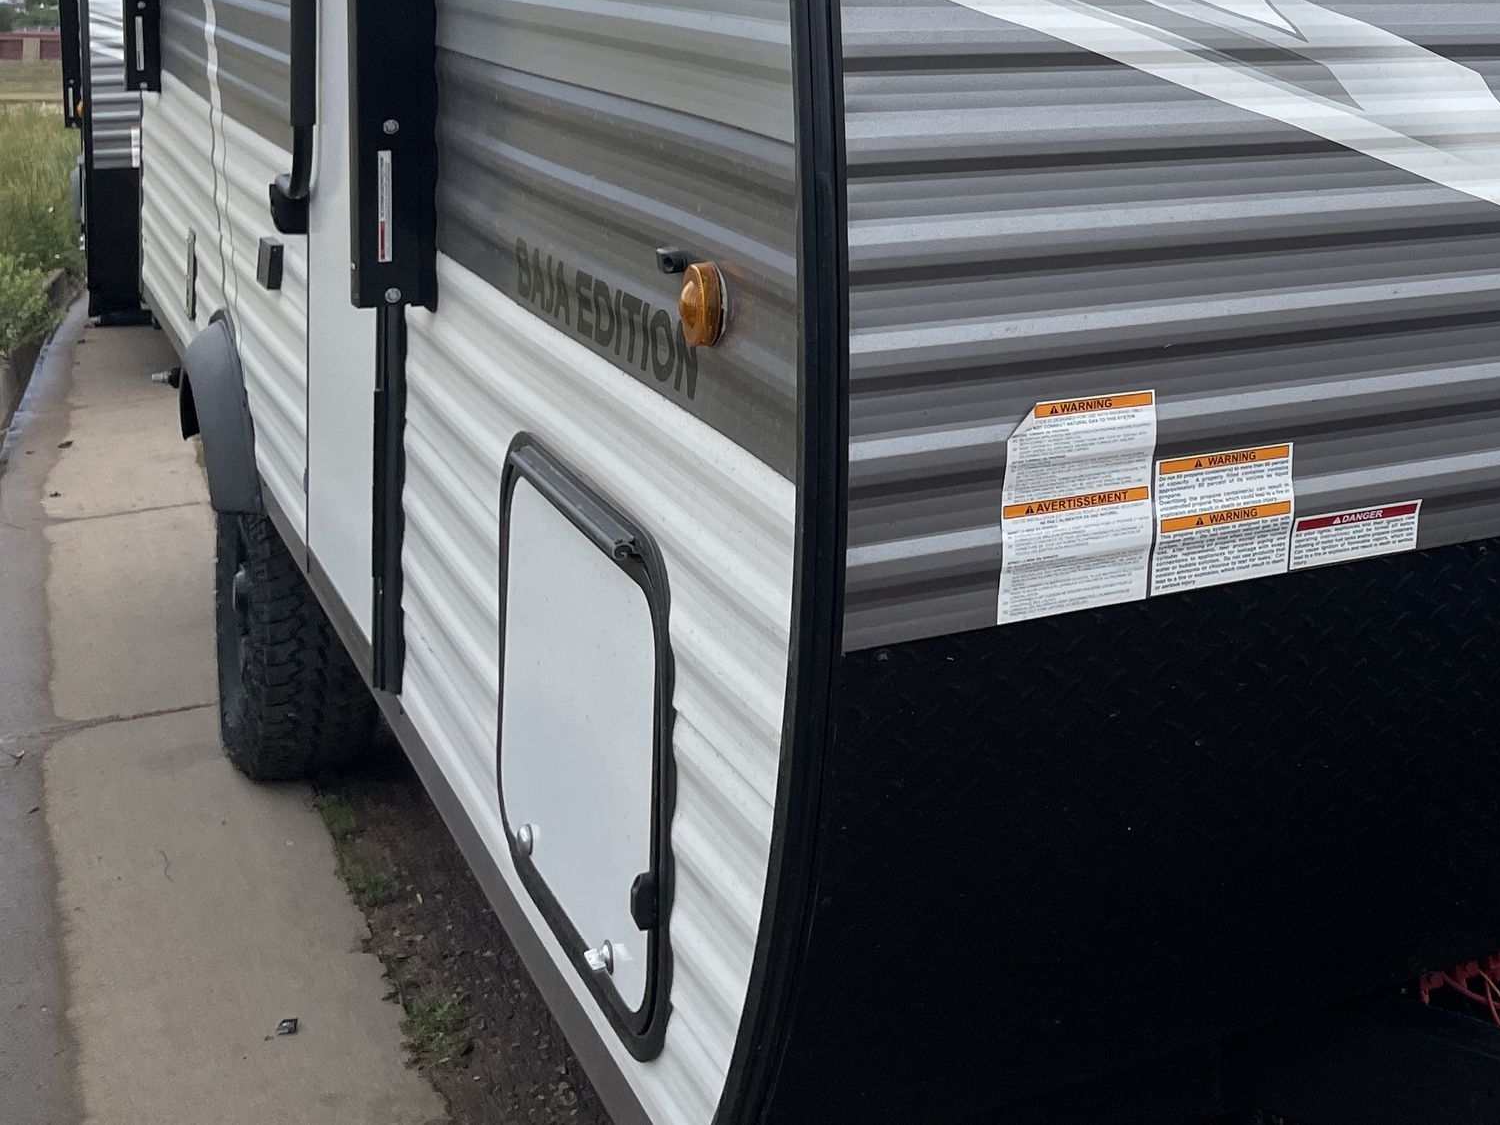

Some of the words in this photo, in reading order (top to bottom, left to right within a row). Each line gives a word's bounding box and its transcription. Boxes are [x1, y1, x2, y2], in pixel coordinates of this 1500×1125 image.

[515, 237, 570, 326] BAJA
[576, 270, 698, 400] EDITION
[1060, 399, 1112, 414] WARNING
[1208, 451, 1256, 466] WARNING
[1036, 491, 1129, 514] AVERTISSEMENT
[1209, 508, 1257, 523] WARNING
[1342, 510, 1383, 523] DANGER
